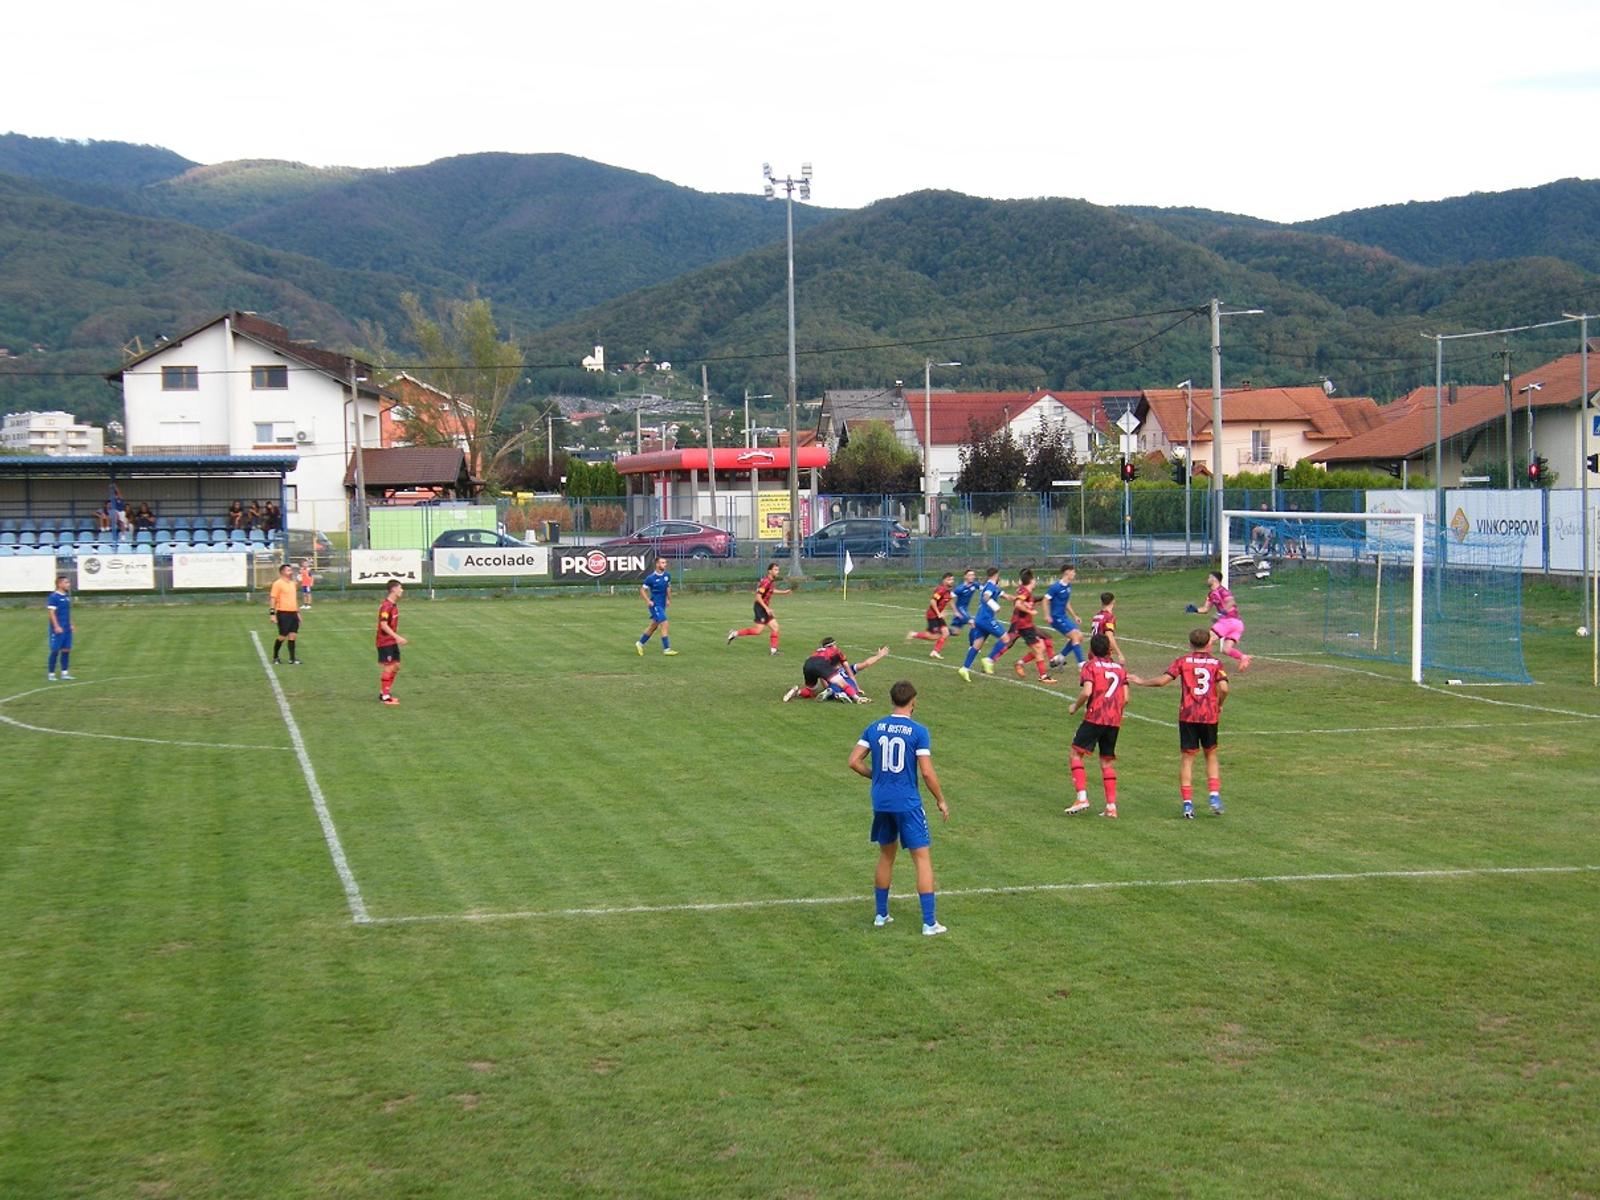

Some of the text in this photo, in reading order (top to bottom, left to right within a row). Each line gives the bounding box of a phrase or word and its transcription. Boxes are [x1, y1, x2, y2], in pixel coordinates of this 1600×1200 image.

[1476, 519, 1539, 536] VINKOPROM
[464, 553, 535, 568] Accolade
[561, 550, 646, 577] PROTEIN
[1104, 671, 1120, 698] 7
[1193, 667, 1211, 696] 3
[878, 735, 906, 774] 10
